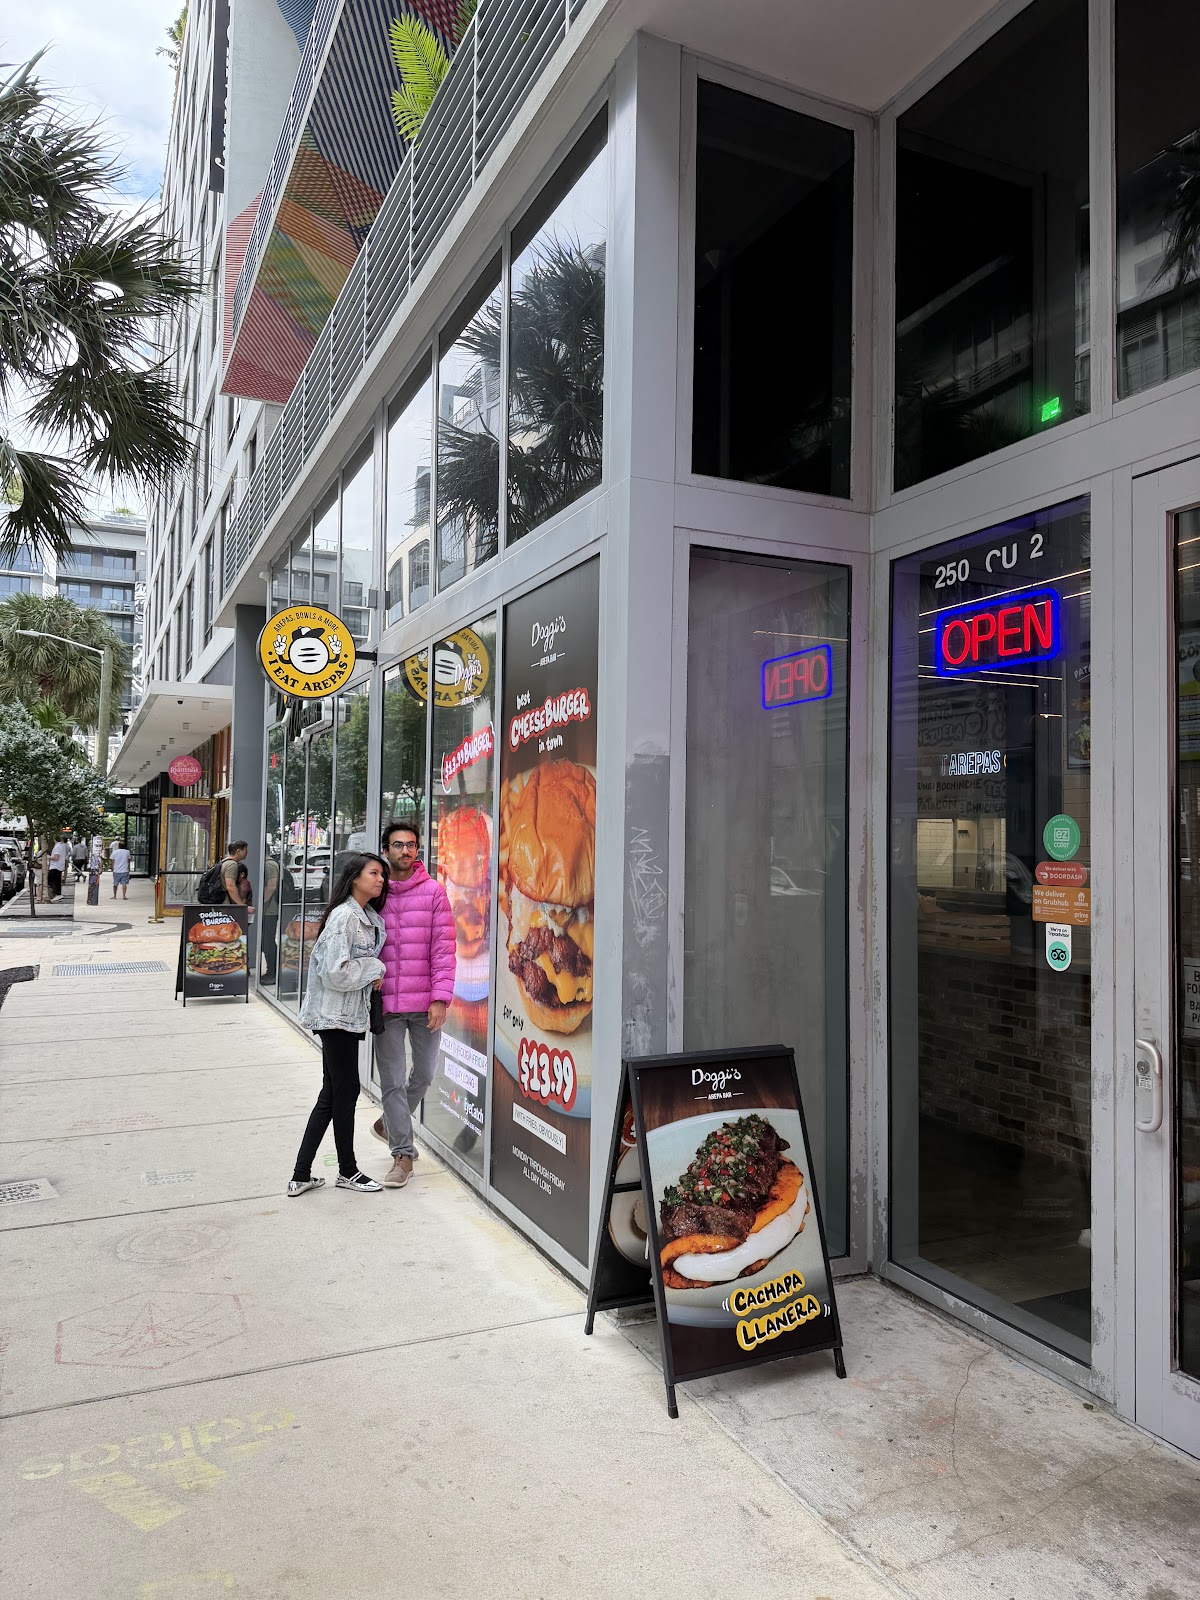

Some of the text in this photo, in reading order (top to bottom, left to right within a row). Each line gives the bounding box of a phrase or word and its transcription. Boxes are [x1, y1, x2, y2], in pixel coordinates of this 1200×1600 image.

[934, 558, 970, 589] 250
[1029, 533, 1044, 560] 2
[296, 612, 317, 620] BOWLS
[323, 619, 339, 632] MORE
[531, 615, 566, 653] Doggi's
[941, 599, 1053, 665] OPEN
[273, 667, 299, 688] EAT
[301, 661, 349, 692] AREPAS
[516, 689, 531, 710] best
[511, 691, 589, 747] CHEESEBURGER
[538, 735, 563, 753] in town
[948, 749, 1001, 776] AREPAS
[936, 779, 982, 792] BOCHINCHE
[1056, 830, 1068, 839] ez
[1042, 898, 1069, 906] Grubhub
[205, 917, 232, 926] BURGER
[503, 1005, 524, 1031] for only
[520, 1043, 574, 1104] $13.99
[691, 1068, 742, 1091] Doggi's
[512, 1145, 566, 1191] MONDAY THROUGH FRIDAY
[522, 1166, 552, 1195] ALL DAY LONG
[734, 1273, 803, 1313] CACHAPA
[741, 1298, 818, 1347] LLANERA
